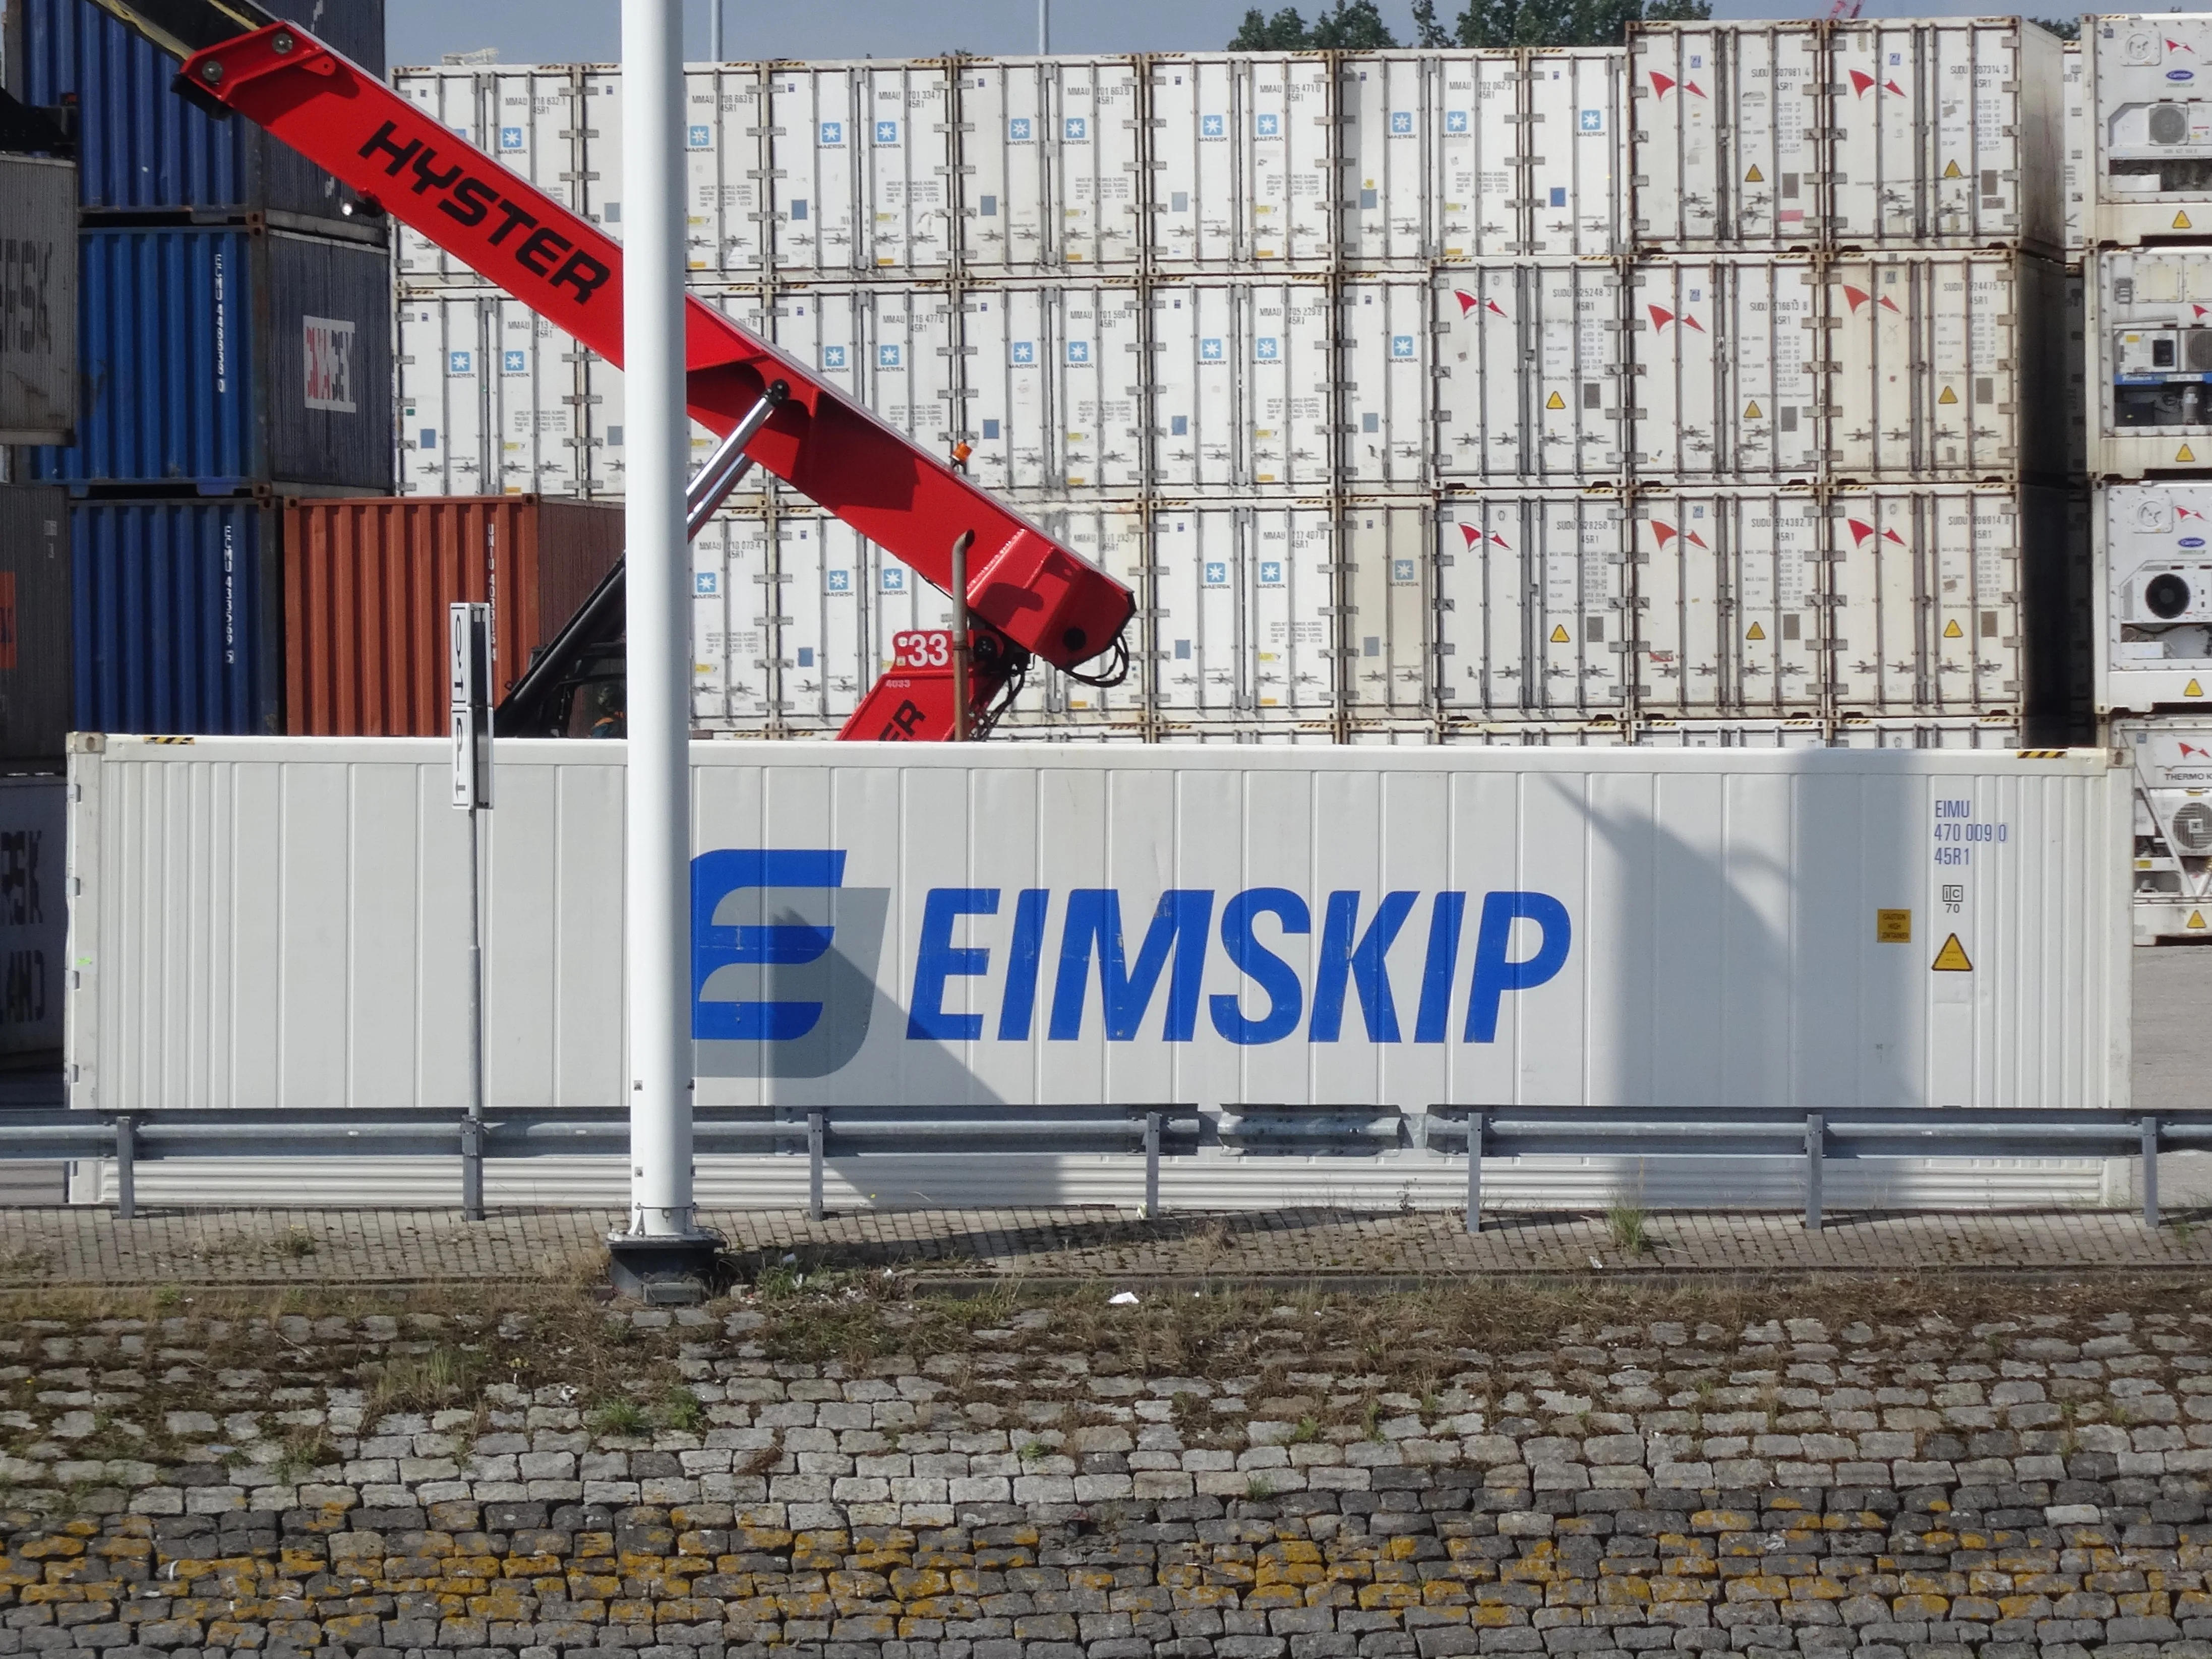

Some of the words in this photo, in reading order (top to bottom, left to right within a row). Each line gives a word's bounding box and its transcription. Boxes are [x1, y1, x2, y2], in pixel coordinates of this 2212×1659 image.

[358, 120, 611, 304] HYSTER
[908, 634, 948, 667] 33
[1935, 800, 1969, 818] EIMU
[1934, 824, 1961, 842] 470
[1966, 824, 1992, 842] 009
[1998, 824, 2006, 842] 0
[1934, 847, 1969, 865] 45R1
[1945, 903, 1960, 913] 70
[907, 888, 1572, 1044] EIMSKIP
[0, 951, 45, 1024] AND
